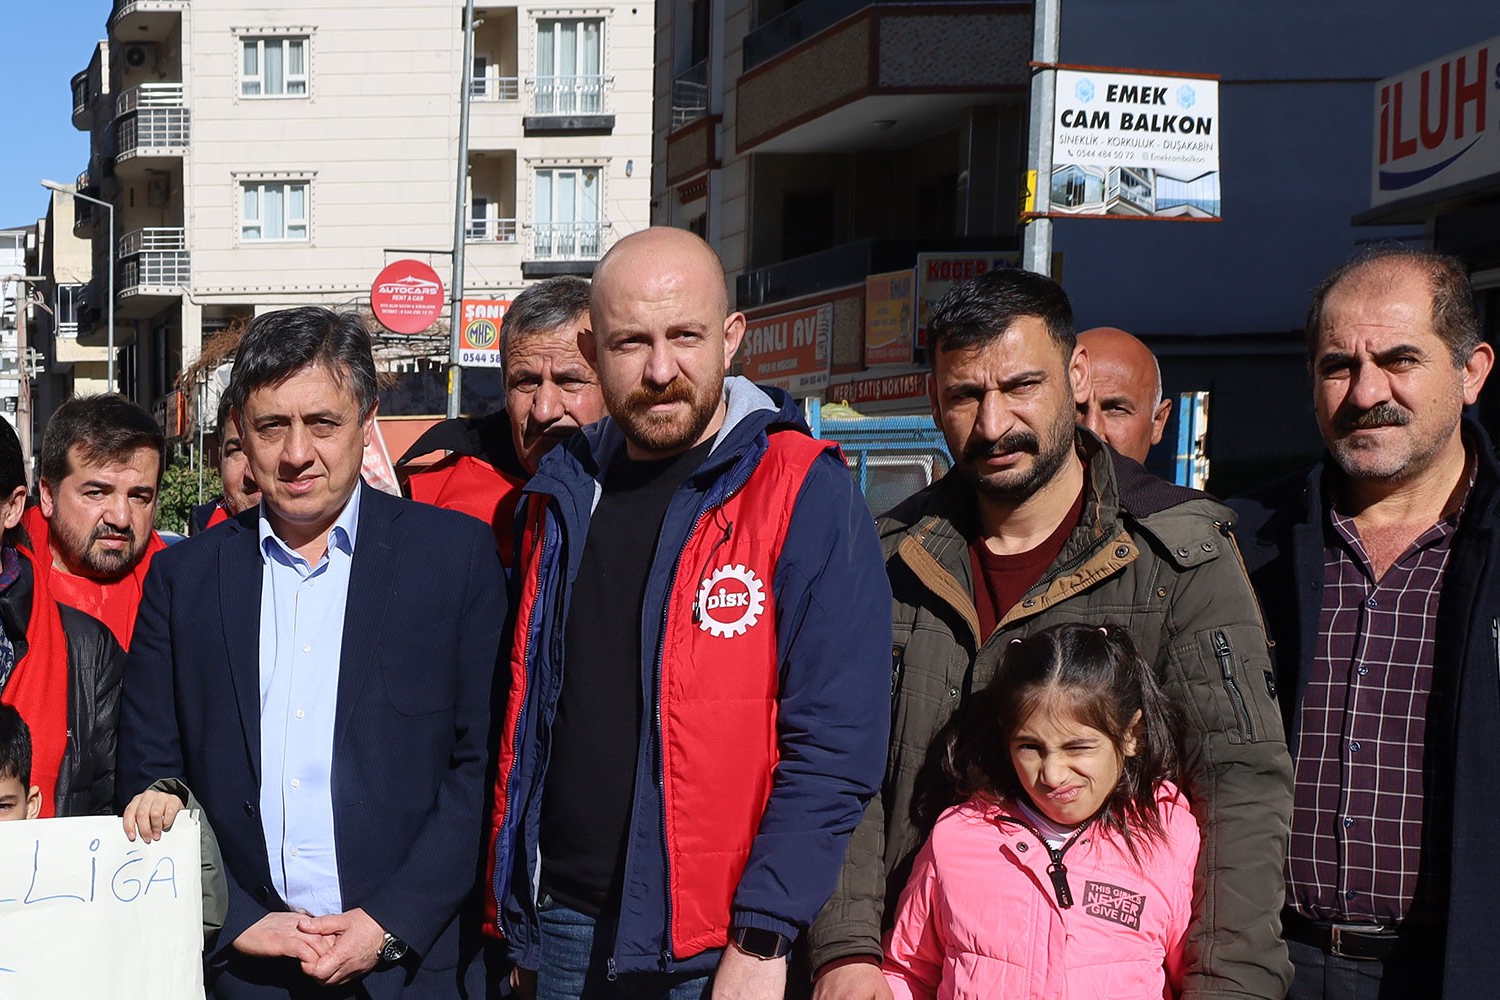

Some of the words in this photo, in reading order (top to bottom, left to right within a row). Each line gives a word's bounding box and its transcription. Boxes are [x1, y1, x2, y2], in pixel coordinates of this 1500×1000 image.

[1105, 84, 1168, 105] EMEK
[1380, 48, 1488, 166] İLUH
[1060, 109, 1110, 130] CAM
[1119, 112, 1212, 135] BALKON
[1058, 132, 1099, 146] SİNEKLİK
[1107, 136, 1153, 148] KORKULUK
[1162, 138, 1213, 153] DUŞAKABİN
[1076, 150, 1096, 158] 0544
[378, 286, 438, 295] AUTOCARS
[465, 304, 508, 323] ŞANL
[743, 321, 788, 365] ŞANLI
[793, 315, 816, 348] AV
[463, 353, 487, 363] 0544
[858, 379, 880, 400] SATIŞ
[707, 587, 749, 610] DİSK
[1089, 883, 1111, 895] THIS
[1087, 892, 1140, 917] NEVER
[1091, 905, 1119, 920] GIVE
